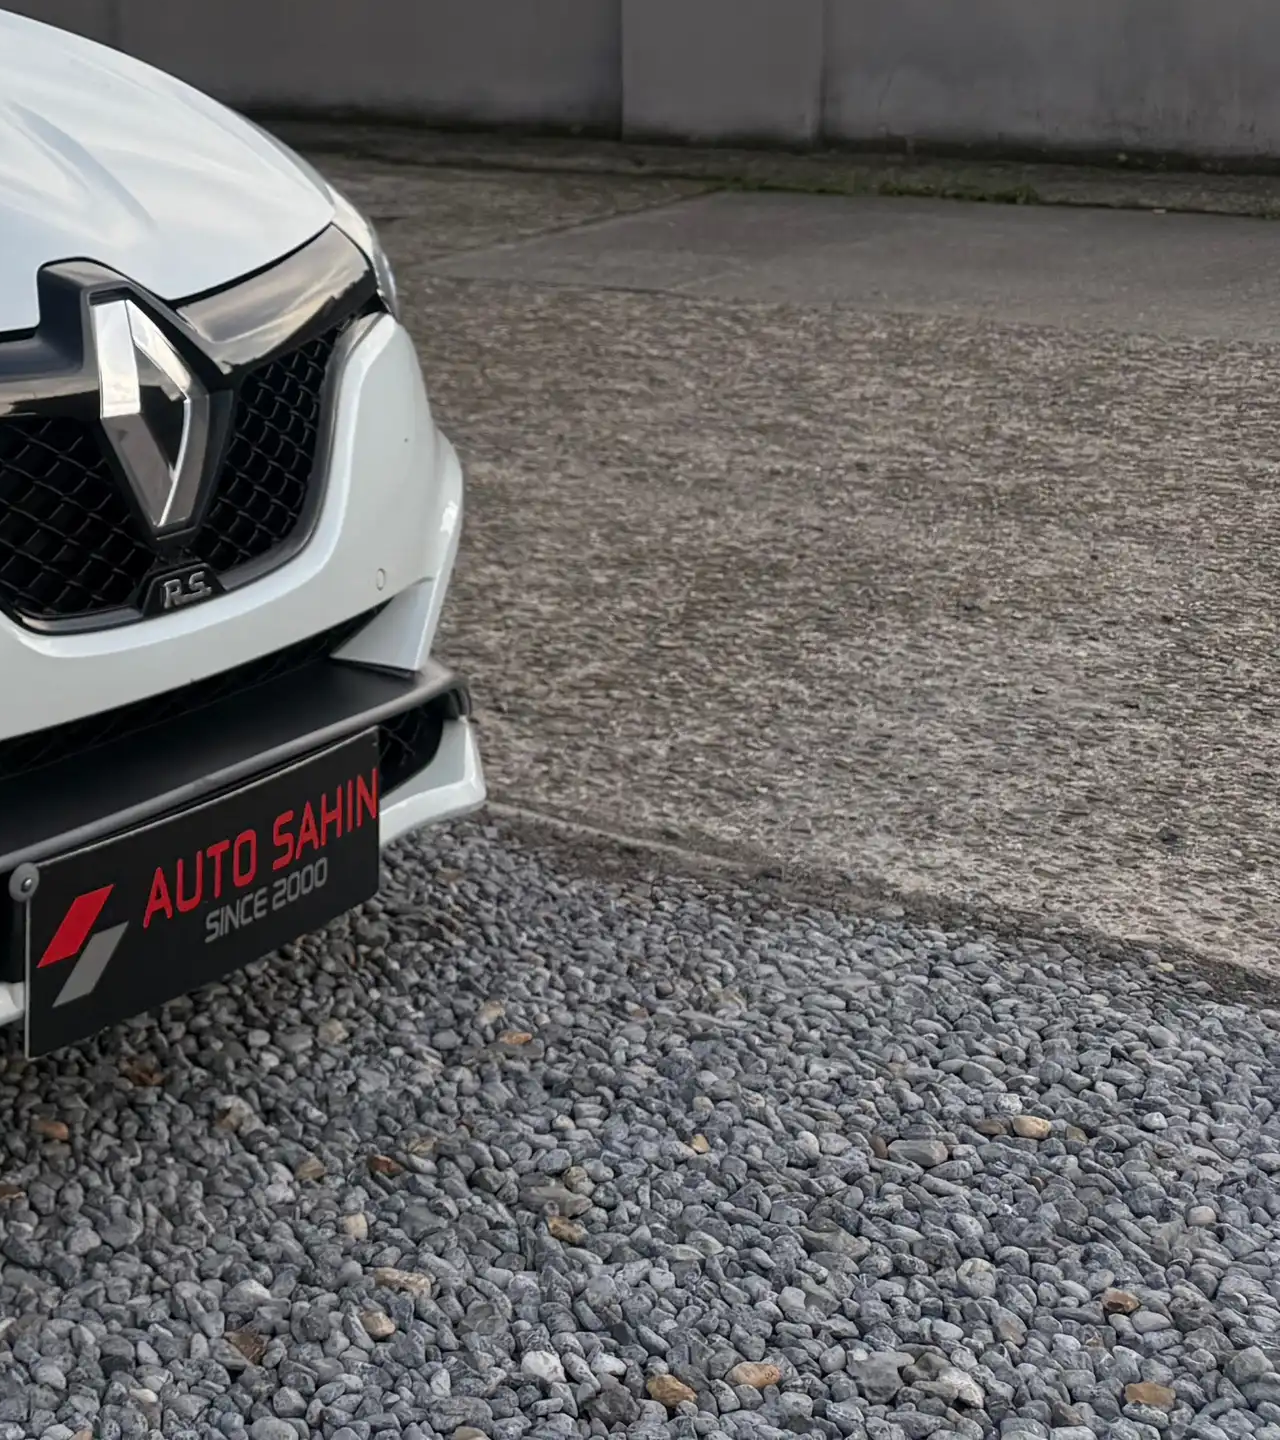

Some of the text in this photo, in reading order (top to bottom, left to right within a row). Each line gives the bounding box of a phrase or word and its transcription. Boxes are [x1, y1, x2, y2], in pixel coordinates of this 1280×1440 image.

[143, 768, 378, 928] AUTO SAHIN
[204, 857, 328, 943] SINCE 2000
